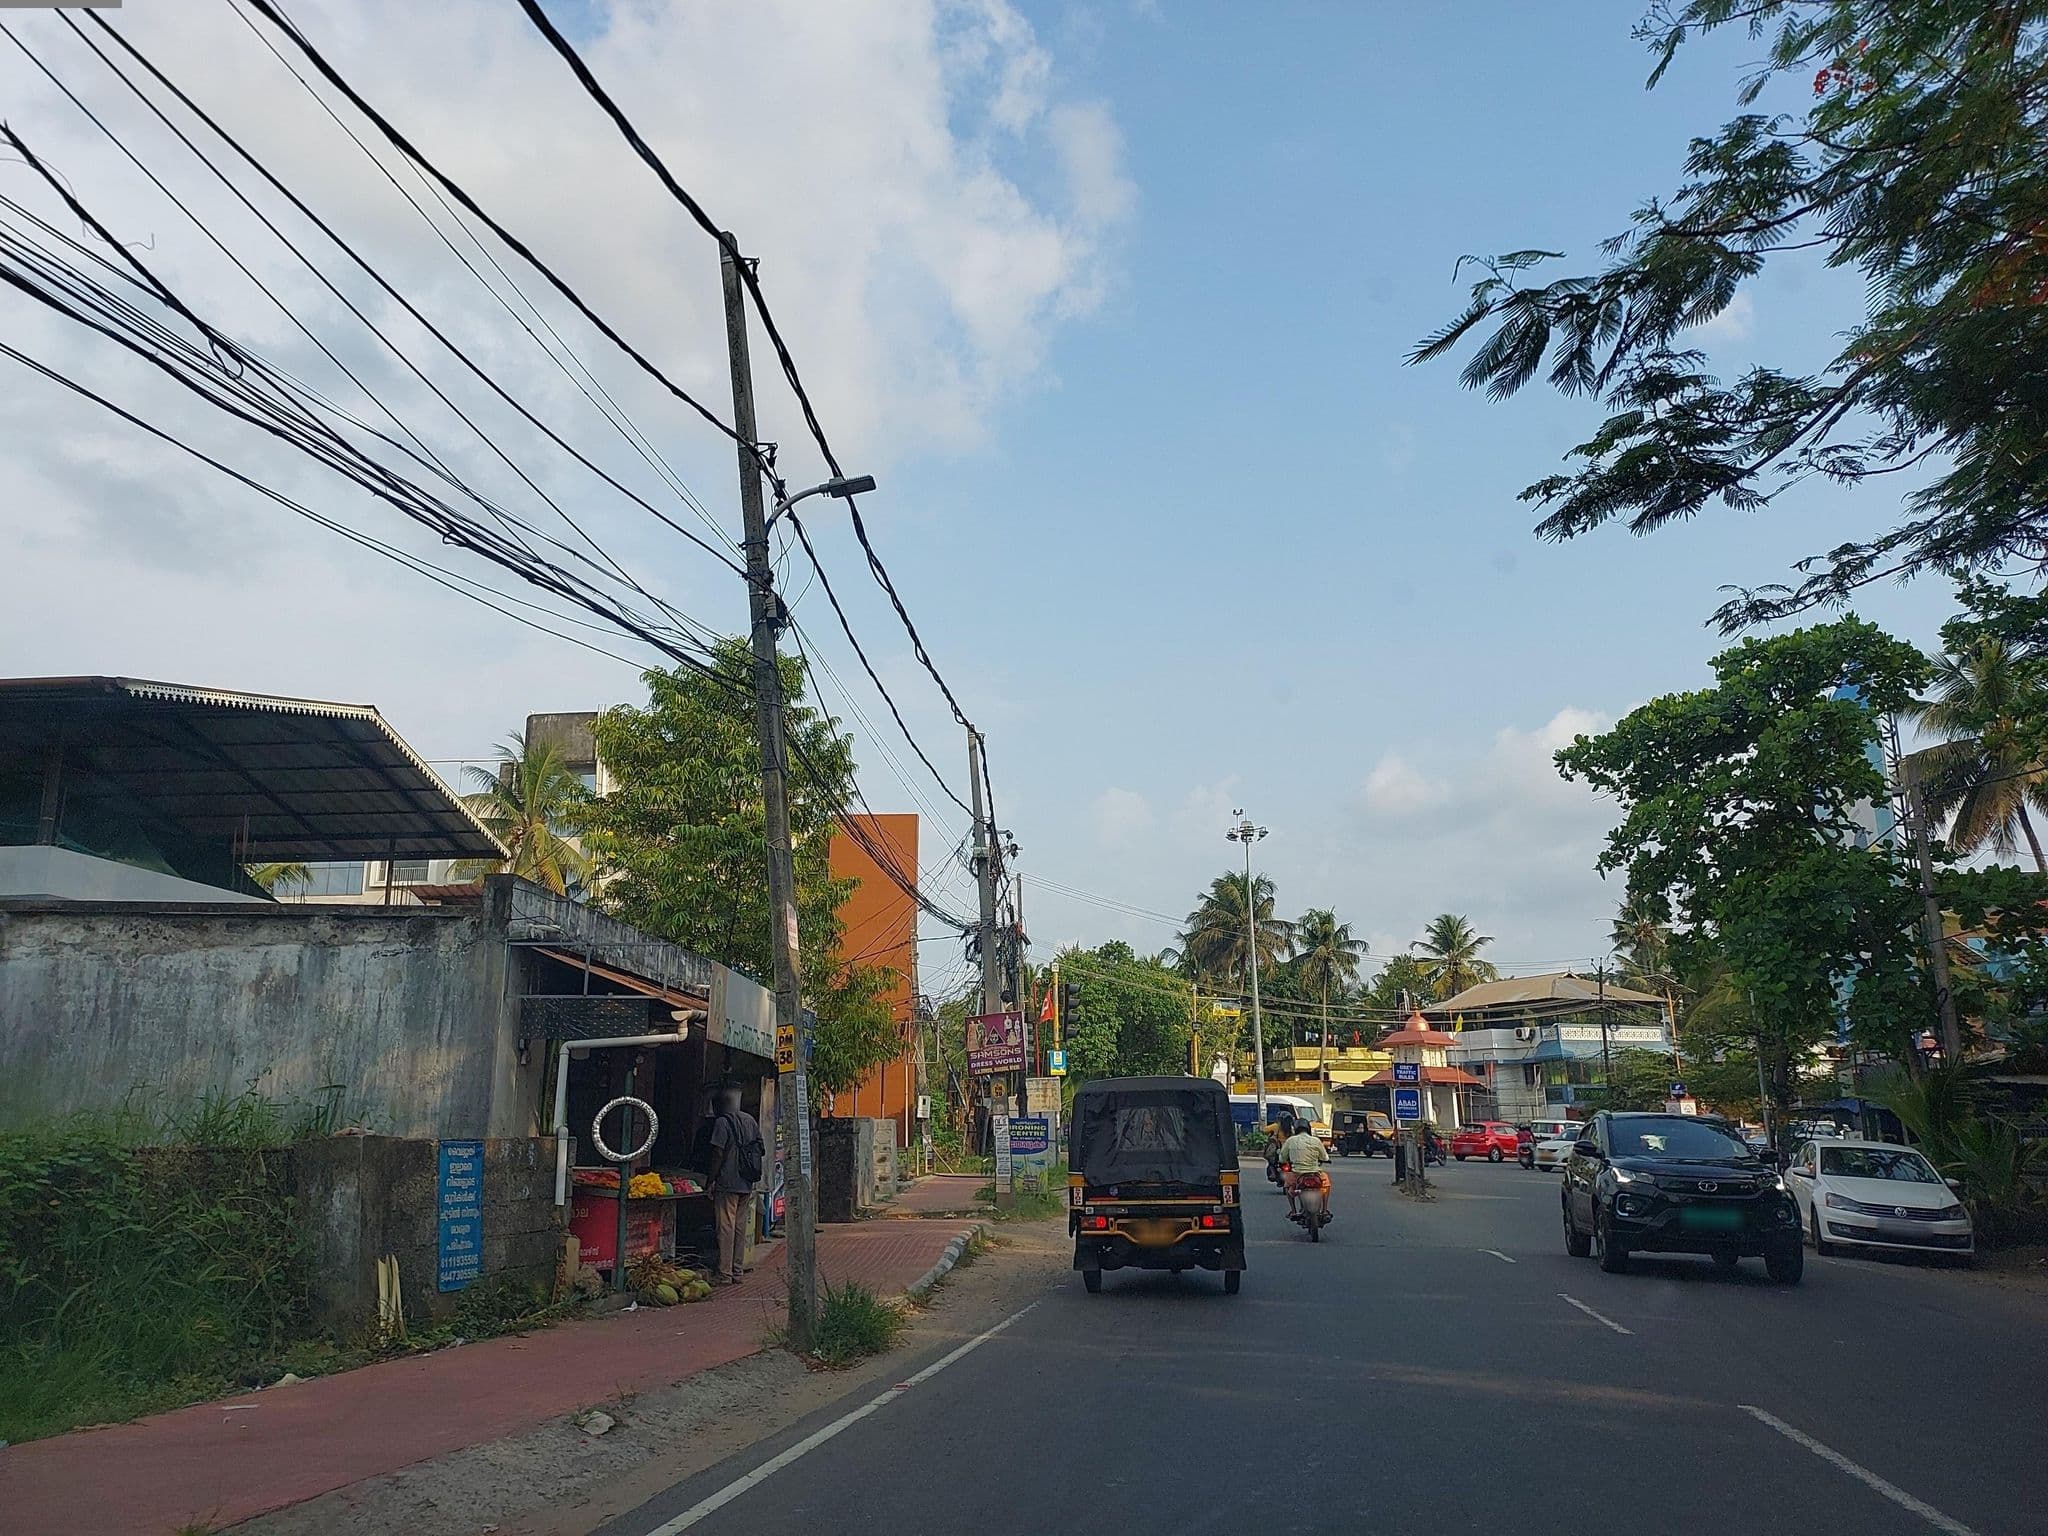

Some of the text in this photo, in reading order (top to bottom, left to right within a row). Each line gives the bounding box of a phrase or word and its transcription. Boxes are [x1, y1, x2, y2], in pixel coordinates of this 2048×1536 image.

[779, 1050, 793, 1064] 38
[970, 1048, 1022, 1060] SAMSONS
[971, 1057, 1022, 1068] DRESS WORLD
[1398, 1099, 1417, 1107] ABAD
